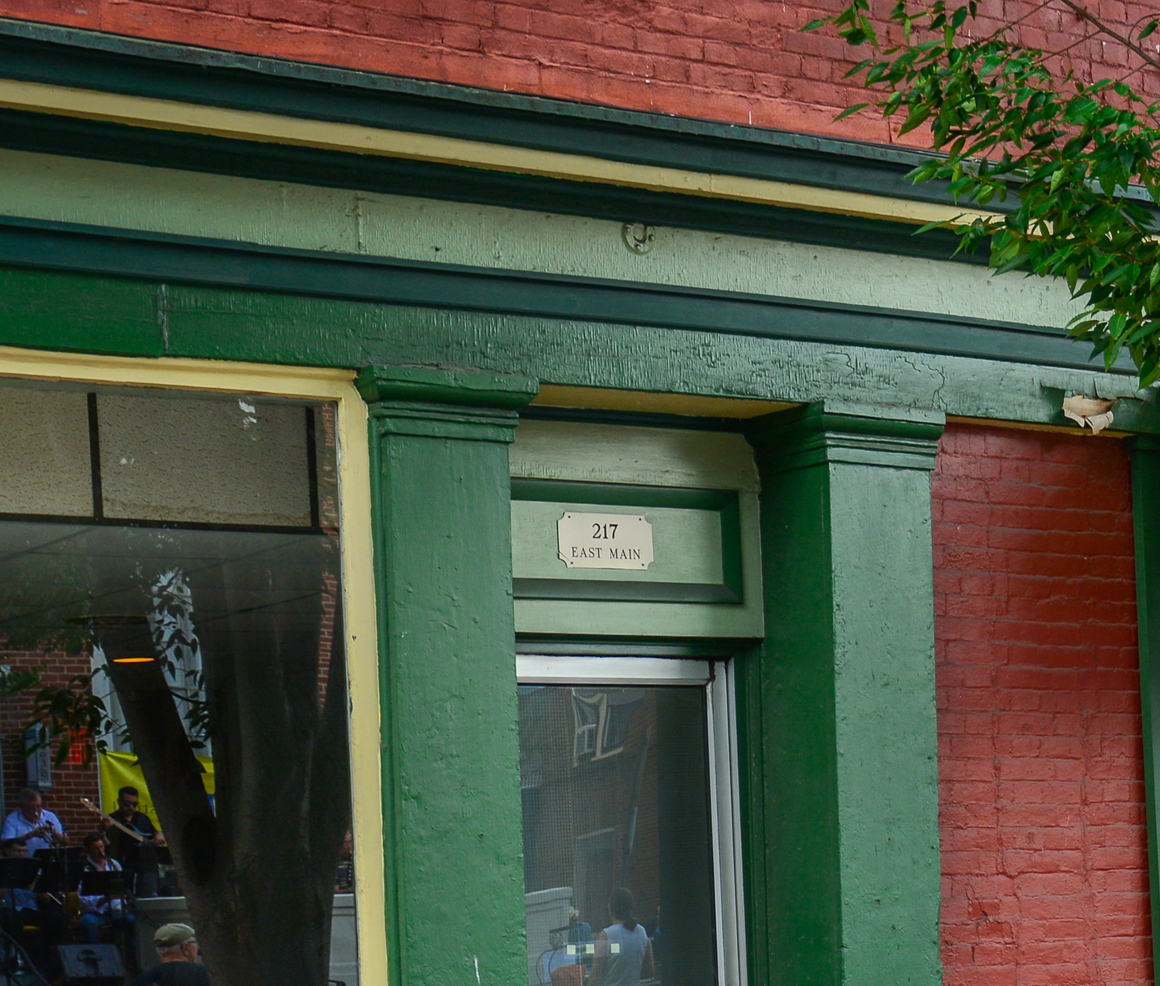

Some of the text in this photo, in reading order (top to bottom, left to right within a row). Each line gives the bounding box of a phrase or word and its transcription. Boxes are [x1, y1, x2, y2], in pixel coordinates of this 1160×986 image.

[592, 523, 618, 539] 217
[571, 546, 641, 560] EAST MAIN
